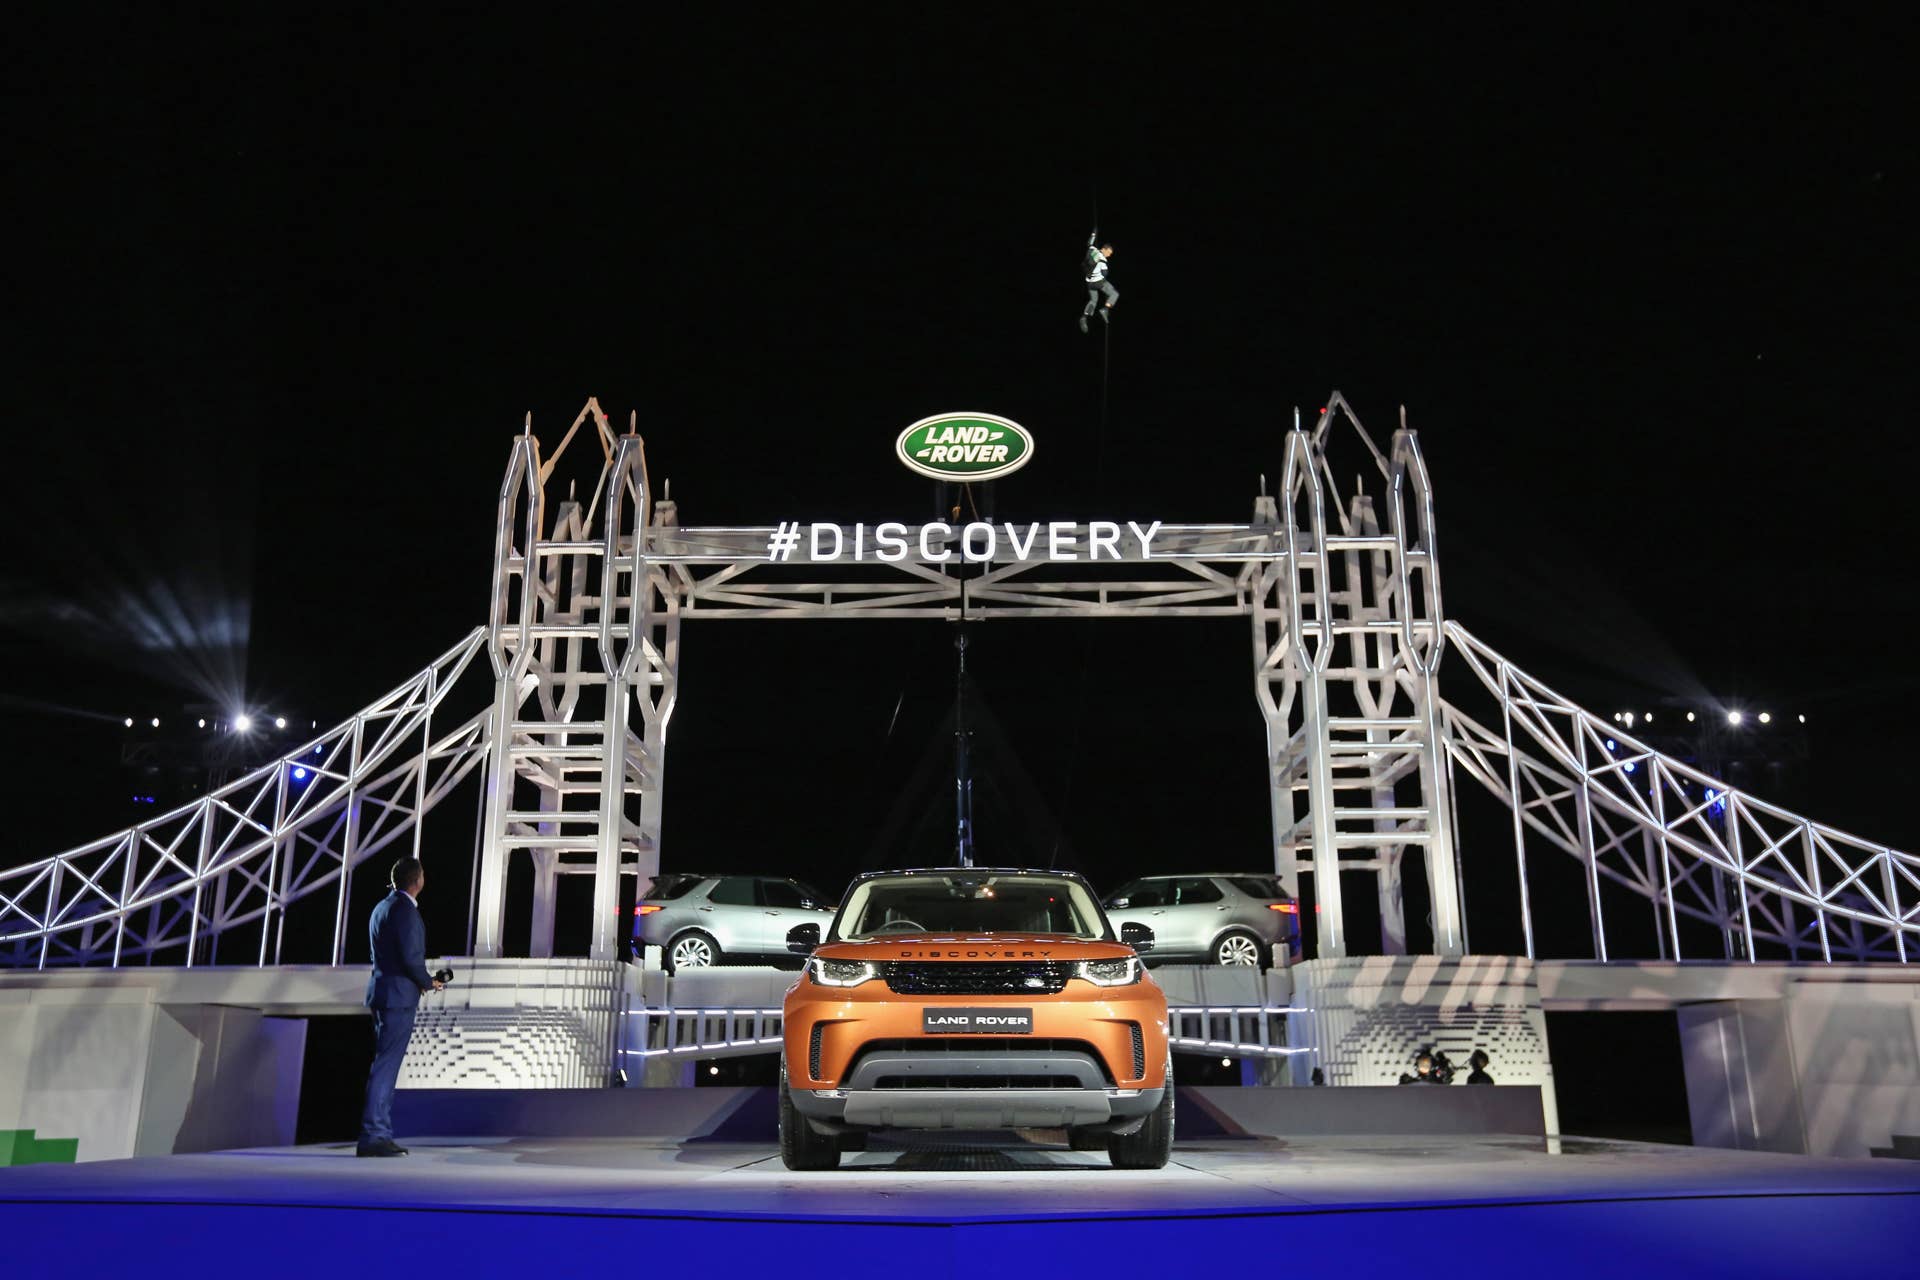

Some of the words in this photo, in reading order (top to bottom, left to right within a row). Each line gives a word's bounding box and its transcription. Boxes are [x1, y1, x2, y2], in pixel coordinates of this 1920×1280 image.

[925, 427, 989, 444] LAND
[930, 445, 1008, 463] ROVER
[767, 521, 1162, 561] #DISCOVERY
[927, 1016, 969, 1025] LAND
[976, 1016, 1028, 1025] ROVER
